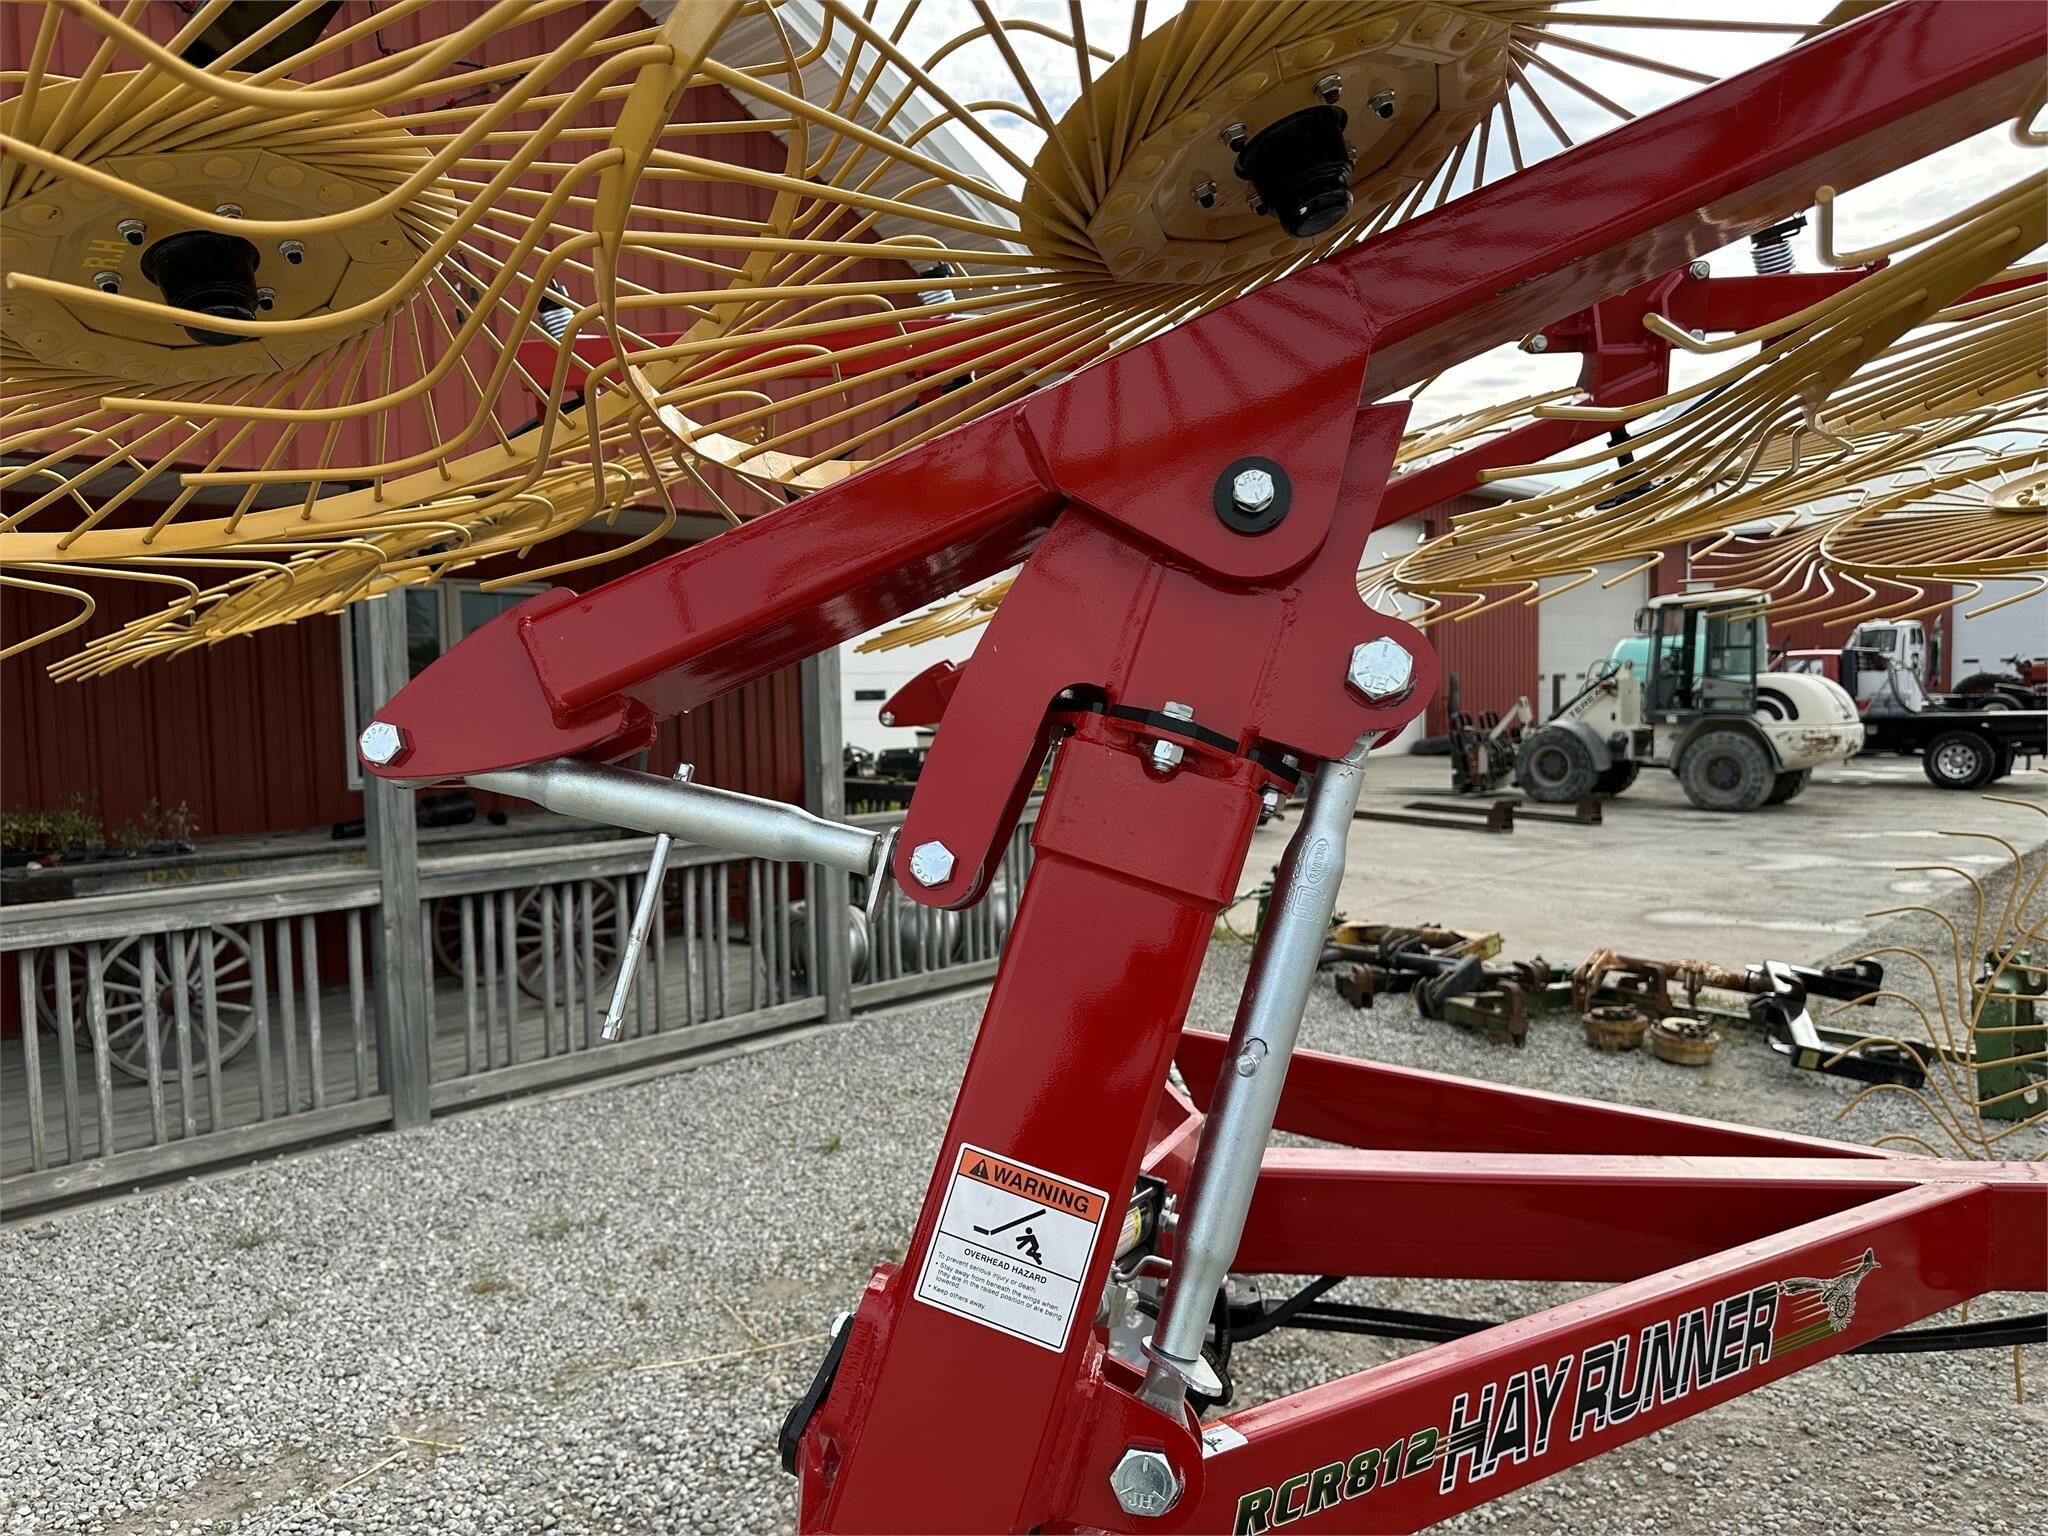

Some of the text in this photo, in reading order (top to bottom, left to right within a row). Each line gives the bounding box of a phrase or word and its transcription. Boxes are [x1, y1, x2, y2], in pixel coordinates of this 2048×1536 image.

[994, 1164, 1089, 1214] WARNING
[938, 1251, 945, 1259] To
[946, 1256, 969, 1268] prevent
[970, 1264, 991, 1276] serious
[992, 1273, 1009, 1284] injury
[940, 1262, 1059, 1311] Stay away from beneath the wings when
[964, 1248, 1047, 1284] OVERHEAD HAZARD
[933, 1285, 949, 1296] Keep
[949, 1292, 969, 1303] others
[937, 1269, 951, 1279] they
[970, 1281, 980, 1289] the
[981, 1286, 1000, 1296] raised
[1000, 1293, 1025, 1306] position
[1045, 1309, 1063, 1321] being
[1232, 1281, 1780, 1536] RCR812 HAY RUNNER
